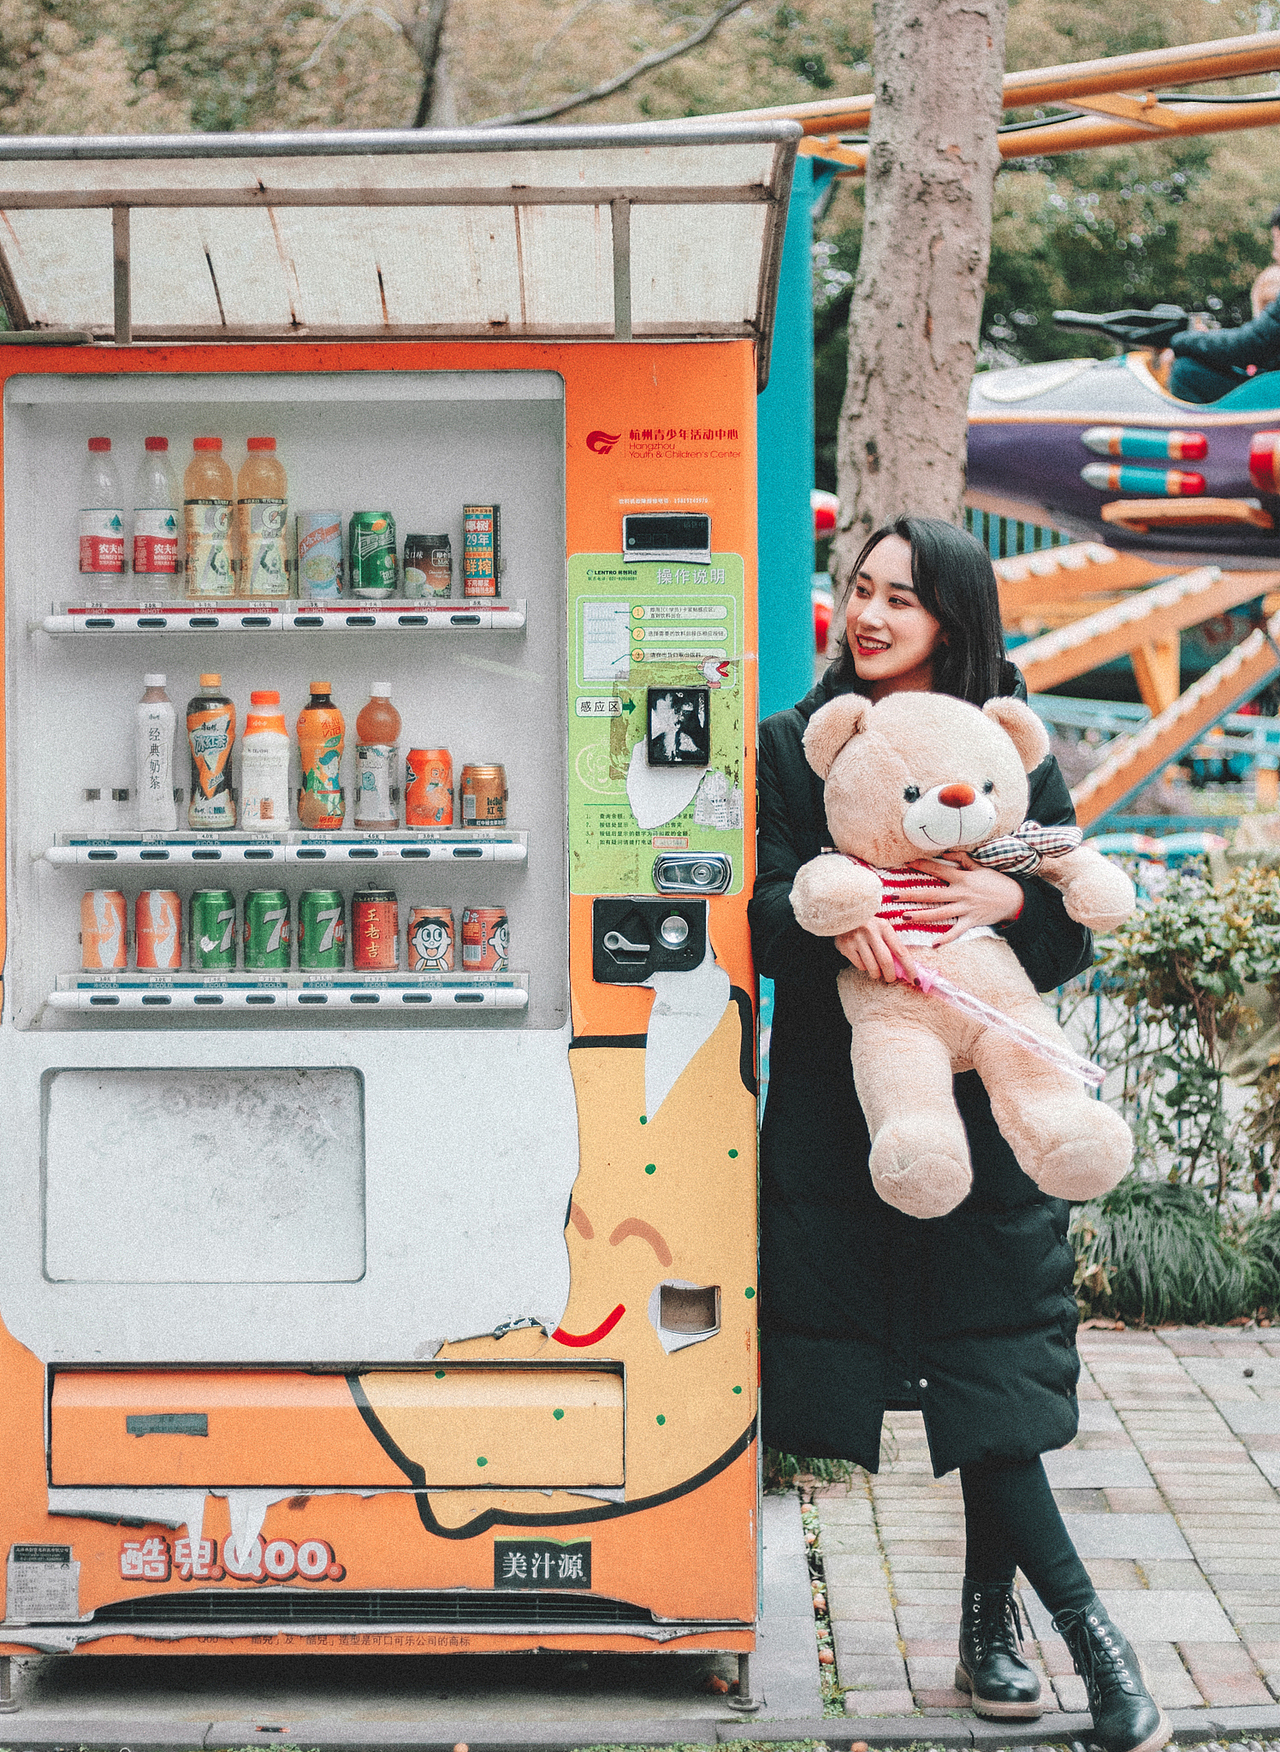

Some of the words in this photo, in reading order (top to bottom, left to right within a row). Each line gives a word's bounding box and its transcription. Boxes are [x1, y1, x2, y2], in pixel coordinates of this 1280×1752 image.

[629, 429, 739, 441] 杭州青少年活动中心
[628, 450, 654, 458] Youth
[656, 450, 662, 458] &
[664, 450, 708, 458] Children's
[710, 450, 741, 458] Center
[629, 442, 675, 452] Hangzhou
[262, 505, 281, 529] G
[466, 520, 489, 532] 椰树
[466, 534, 490, 546] 29年
[464, 559, 492, 575] 鲜榨
[656, 568, 726, 584] 操作说明
[580, 701, 619, 712] 感应区
[194, 734, 228, 756] 冰红茶
[149, 727, 161, 790] 经典奶茶
[217, 908, 236, 954] 7
[263, 906, 288, 954] 7
[316, 906, 342, 954] 7
[364, 908, 380, 958] 王老吉
[122, 1538, 213, 1577] 酷兒
[224, 1536, 328, 1577] Qoo
[502, 1552, 584, 1579] 美汁源
